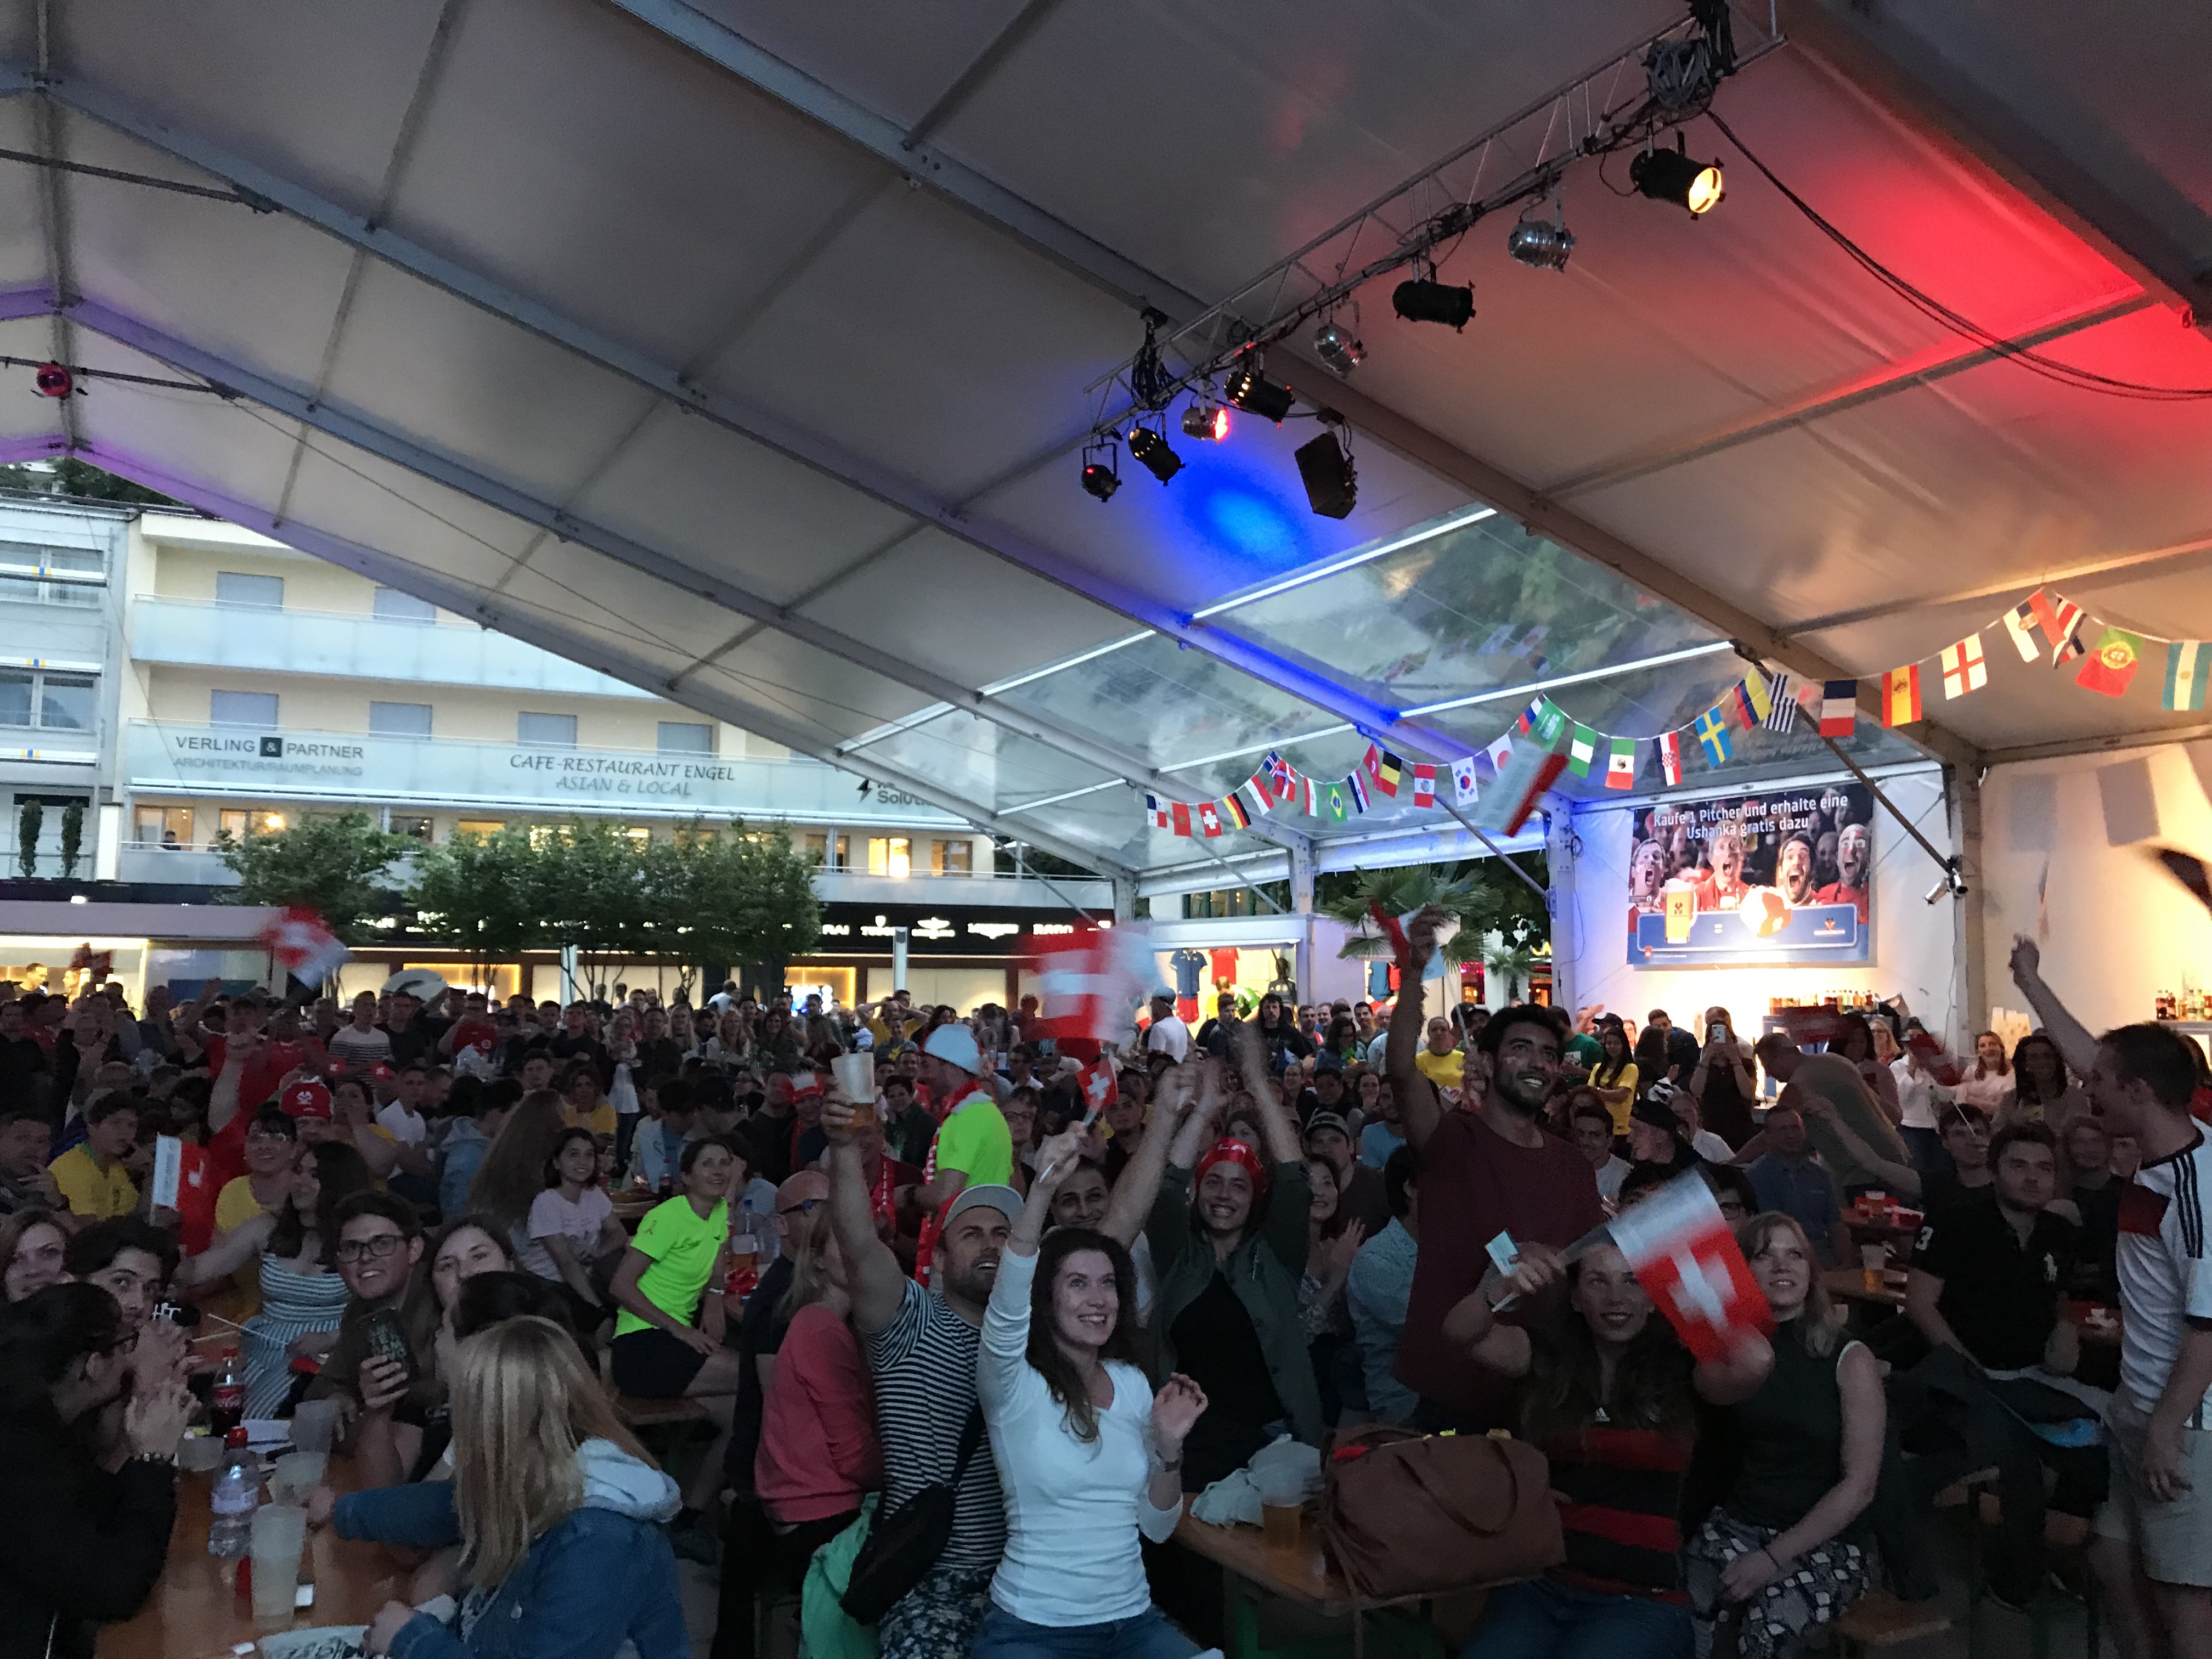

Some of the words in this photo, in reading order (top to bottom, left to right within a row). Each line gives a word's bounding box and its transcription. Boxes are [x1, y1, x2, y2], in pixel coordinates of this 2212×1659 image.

[175, 736, 255, 752] VERLING
[286, 742, 364, 758] PARTNER
[684, 764, 735, 781] ENGEL
[556, 776, 612, 791] ASIAN
[618, 778, 631, 793] &
[637, 781, 692, 796] LOCAL
[1654, 811, 1685, 827] Kaufe
[1689, 812, 1696, 823] 1
[1700, 806, 1741, 822] Pitcher
[1745, 802, 1767, 818] und
[1770, 798, 1817, 815] erhalte
[1820, 794, 1848, 809] eine
[1687, 823, 1736, 840] Ushanka
[1740, 817, 1775, 837] gratis
[1779, 816, 1809, 831] dazu
[1915, 1225, 1934, 1251] 3
